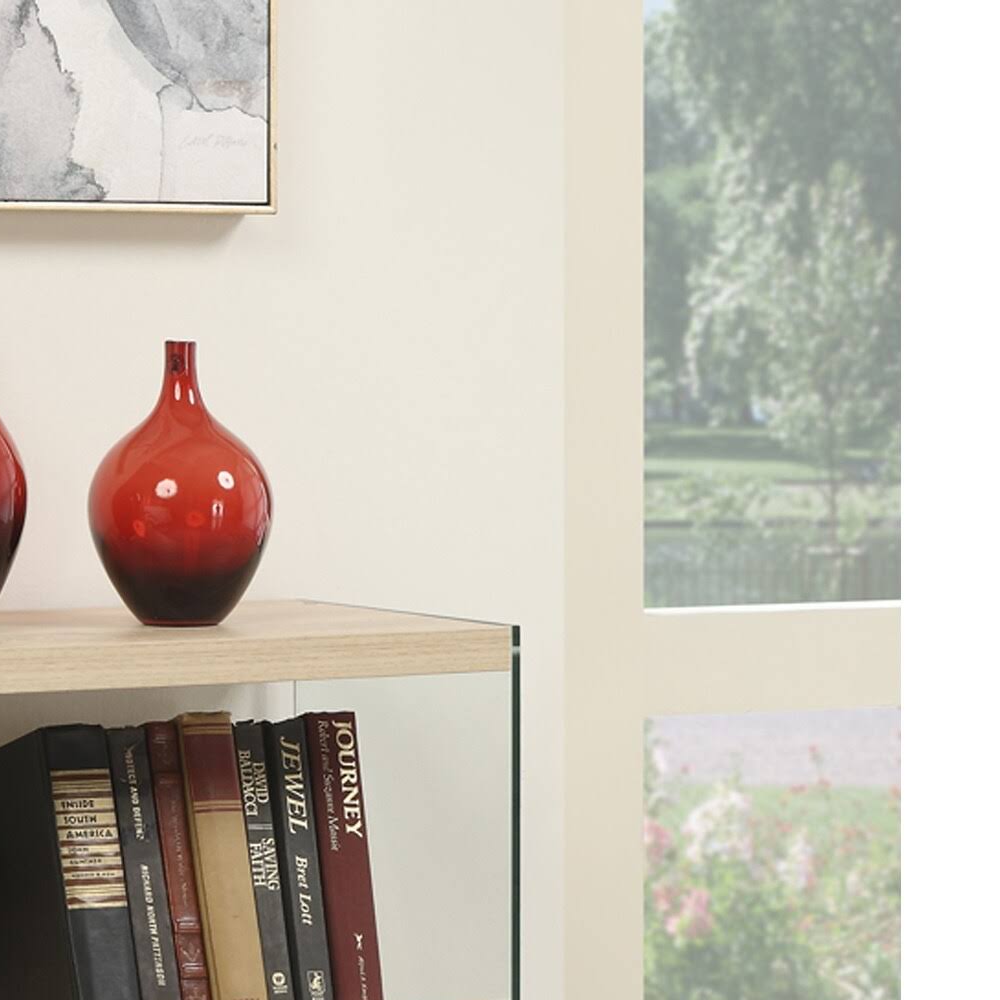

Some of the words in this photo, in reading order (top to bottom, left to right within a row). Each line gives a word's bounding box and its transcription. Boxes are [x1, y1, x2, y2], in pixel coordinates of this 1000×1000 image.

[130, 787, 140, 804] AND
[253, 762, 270, 804] DAVID
[280, 736, 308, 835] JEWEL
[332, 720, 363, 838] JOURNEY
[60, 800, 94, 809] INSIDE
[63, 814, 97, 824] SOUTH
[66, 829, 113, 840] AMERICA
[250, 842, 266, 887] FAITH
[262, 838, 280, 891] SAVING
[295, 855, 309, 888] Bret
[300, 892, 313, 926] Lott
